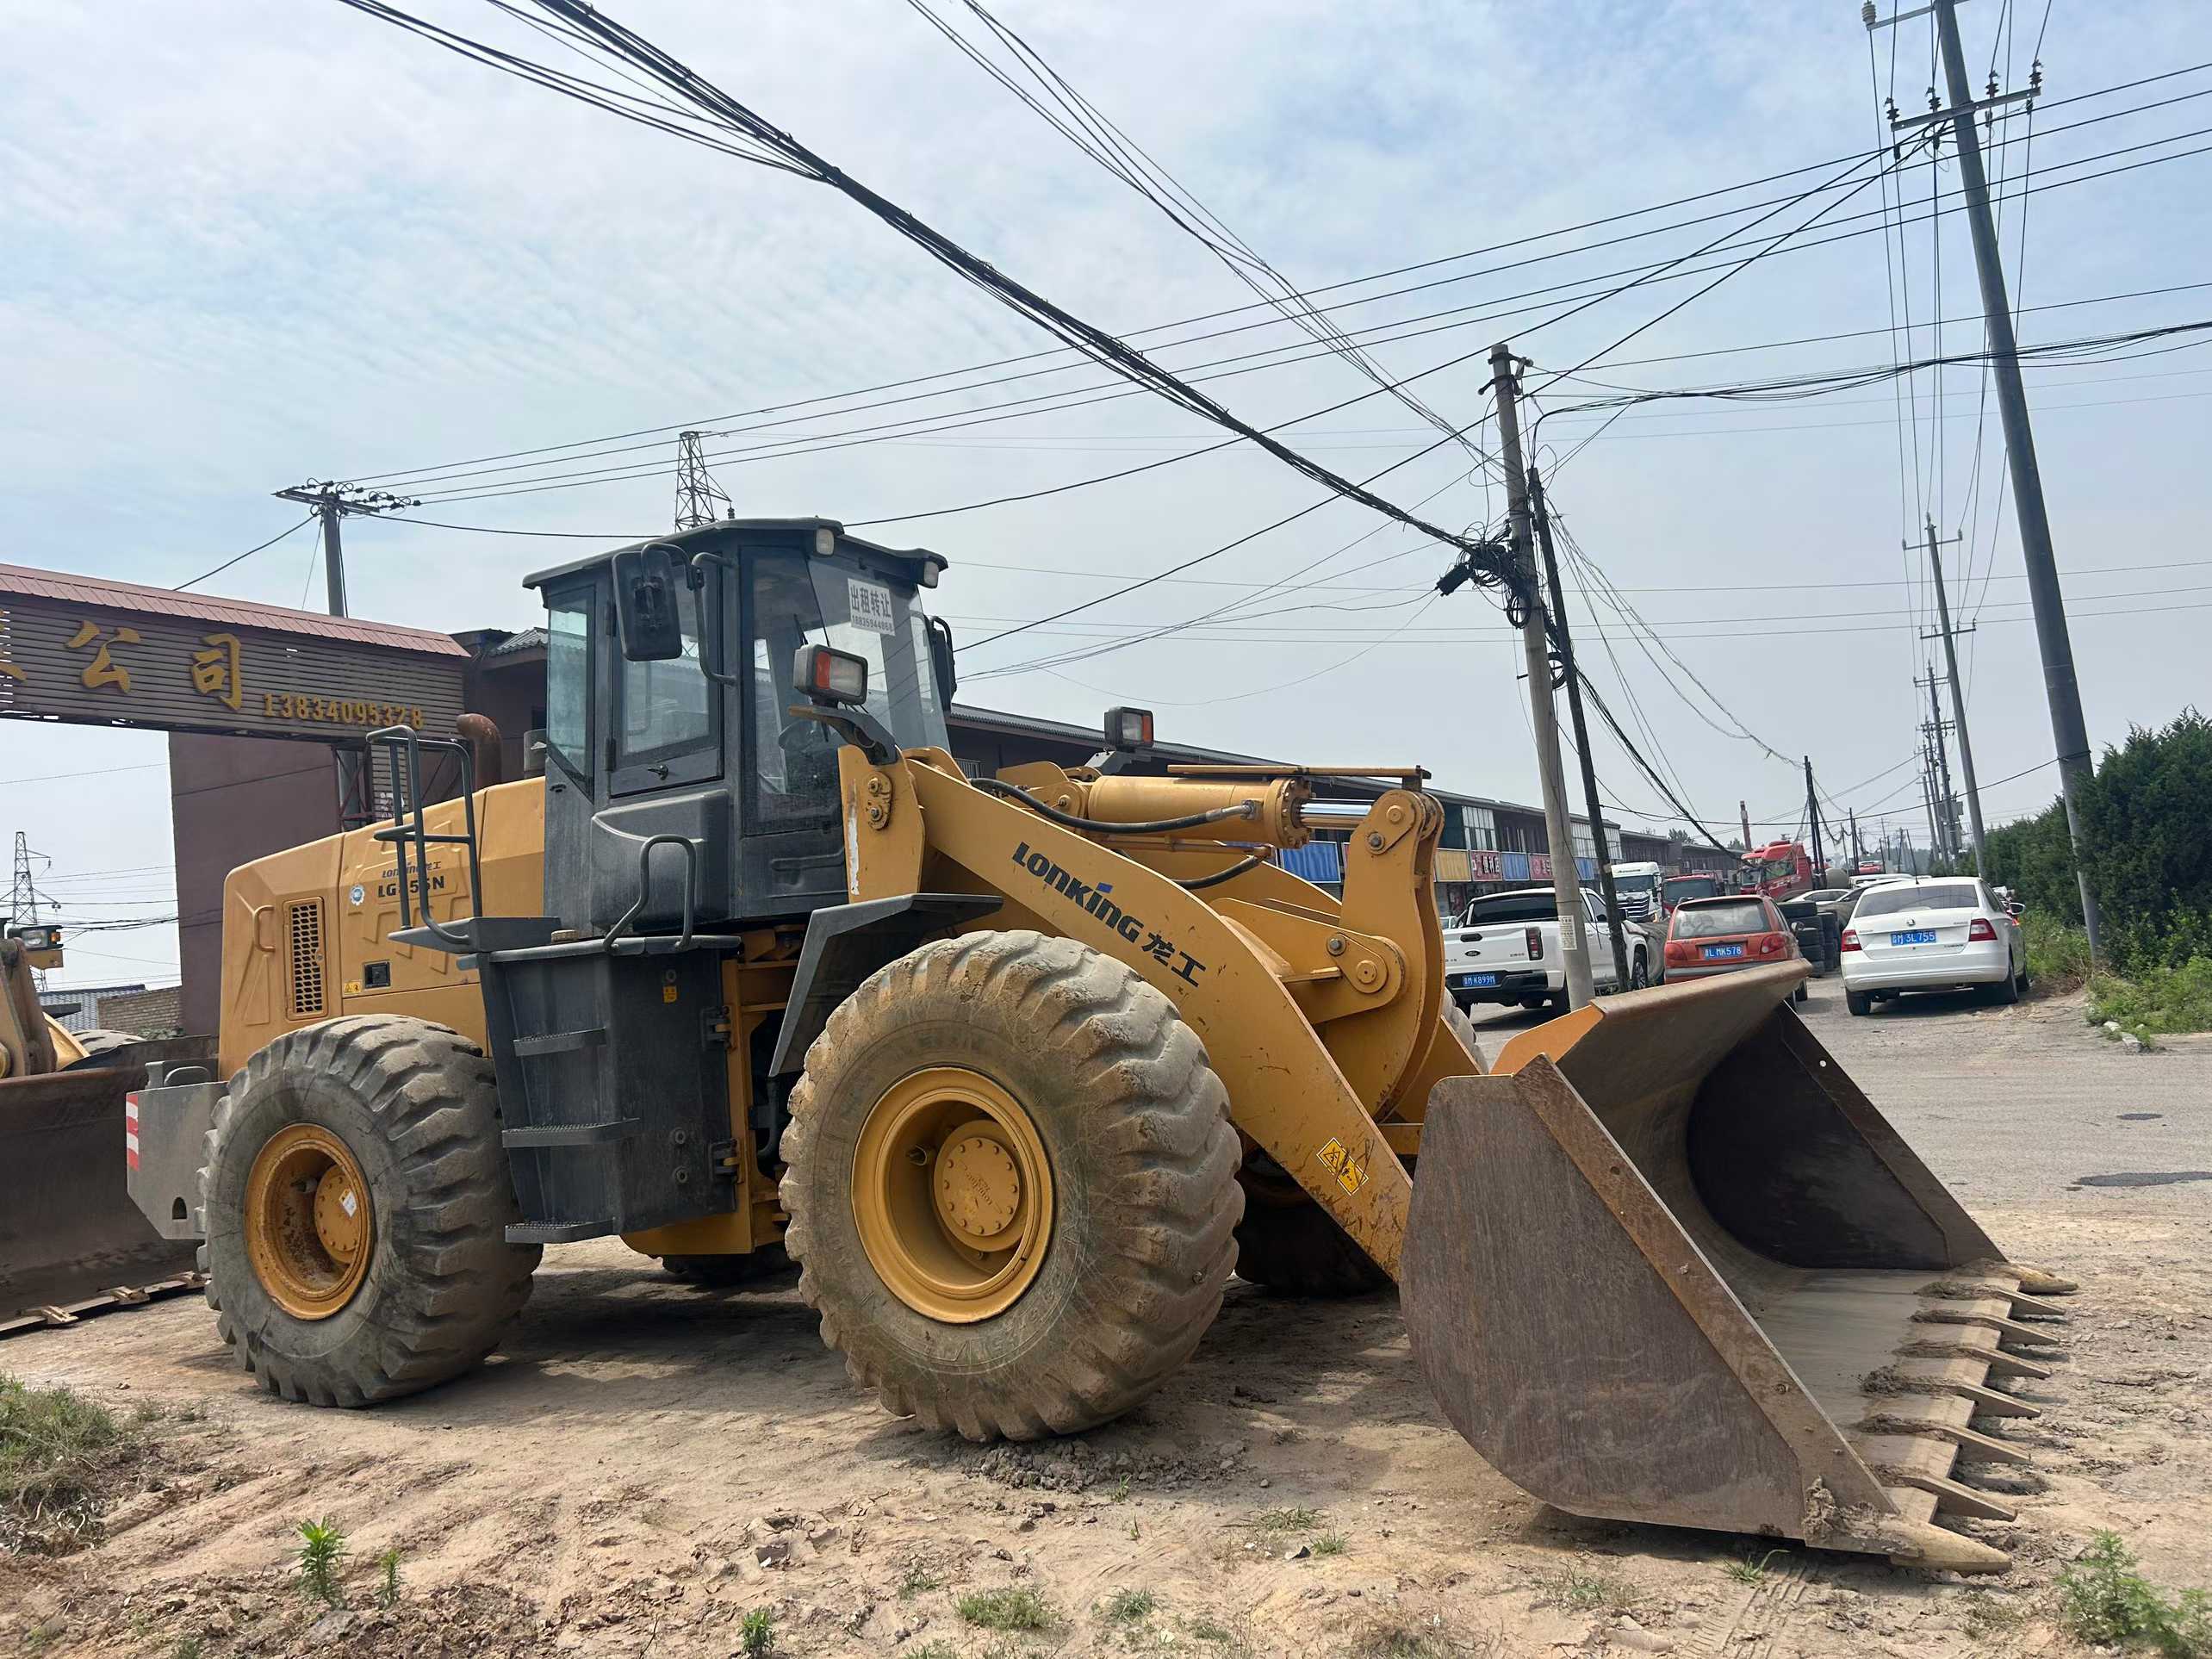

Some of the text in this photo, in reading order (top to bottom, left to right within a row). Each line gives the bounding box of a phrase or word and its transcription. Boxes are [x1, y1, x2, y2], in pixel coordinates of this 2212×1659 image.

[851, 586, 891, 618] 出租转让
[0, 609, 242, 711] 公司
[378, 875, 444, 898] LG5N
[1142, 932, 1206, 987] 龙工
